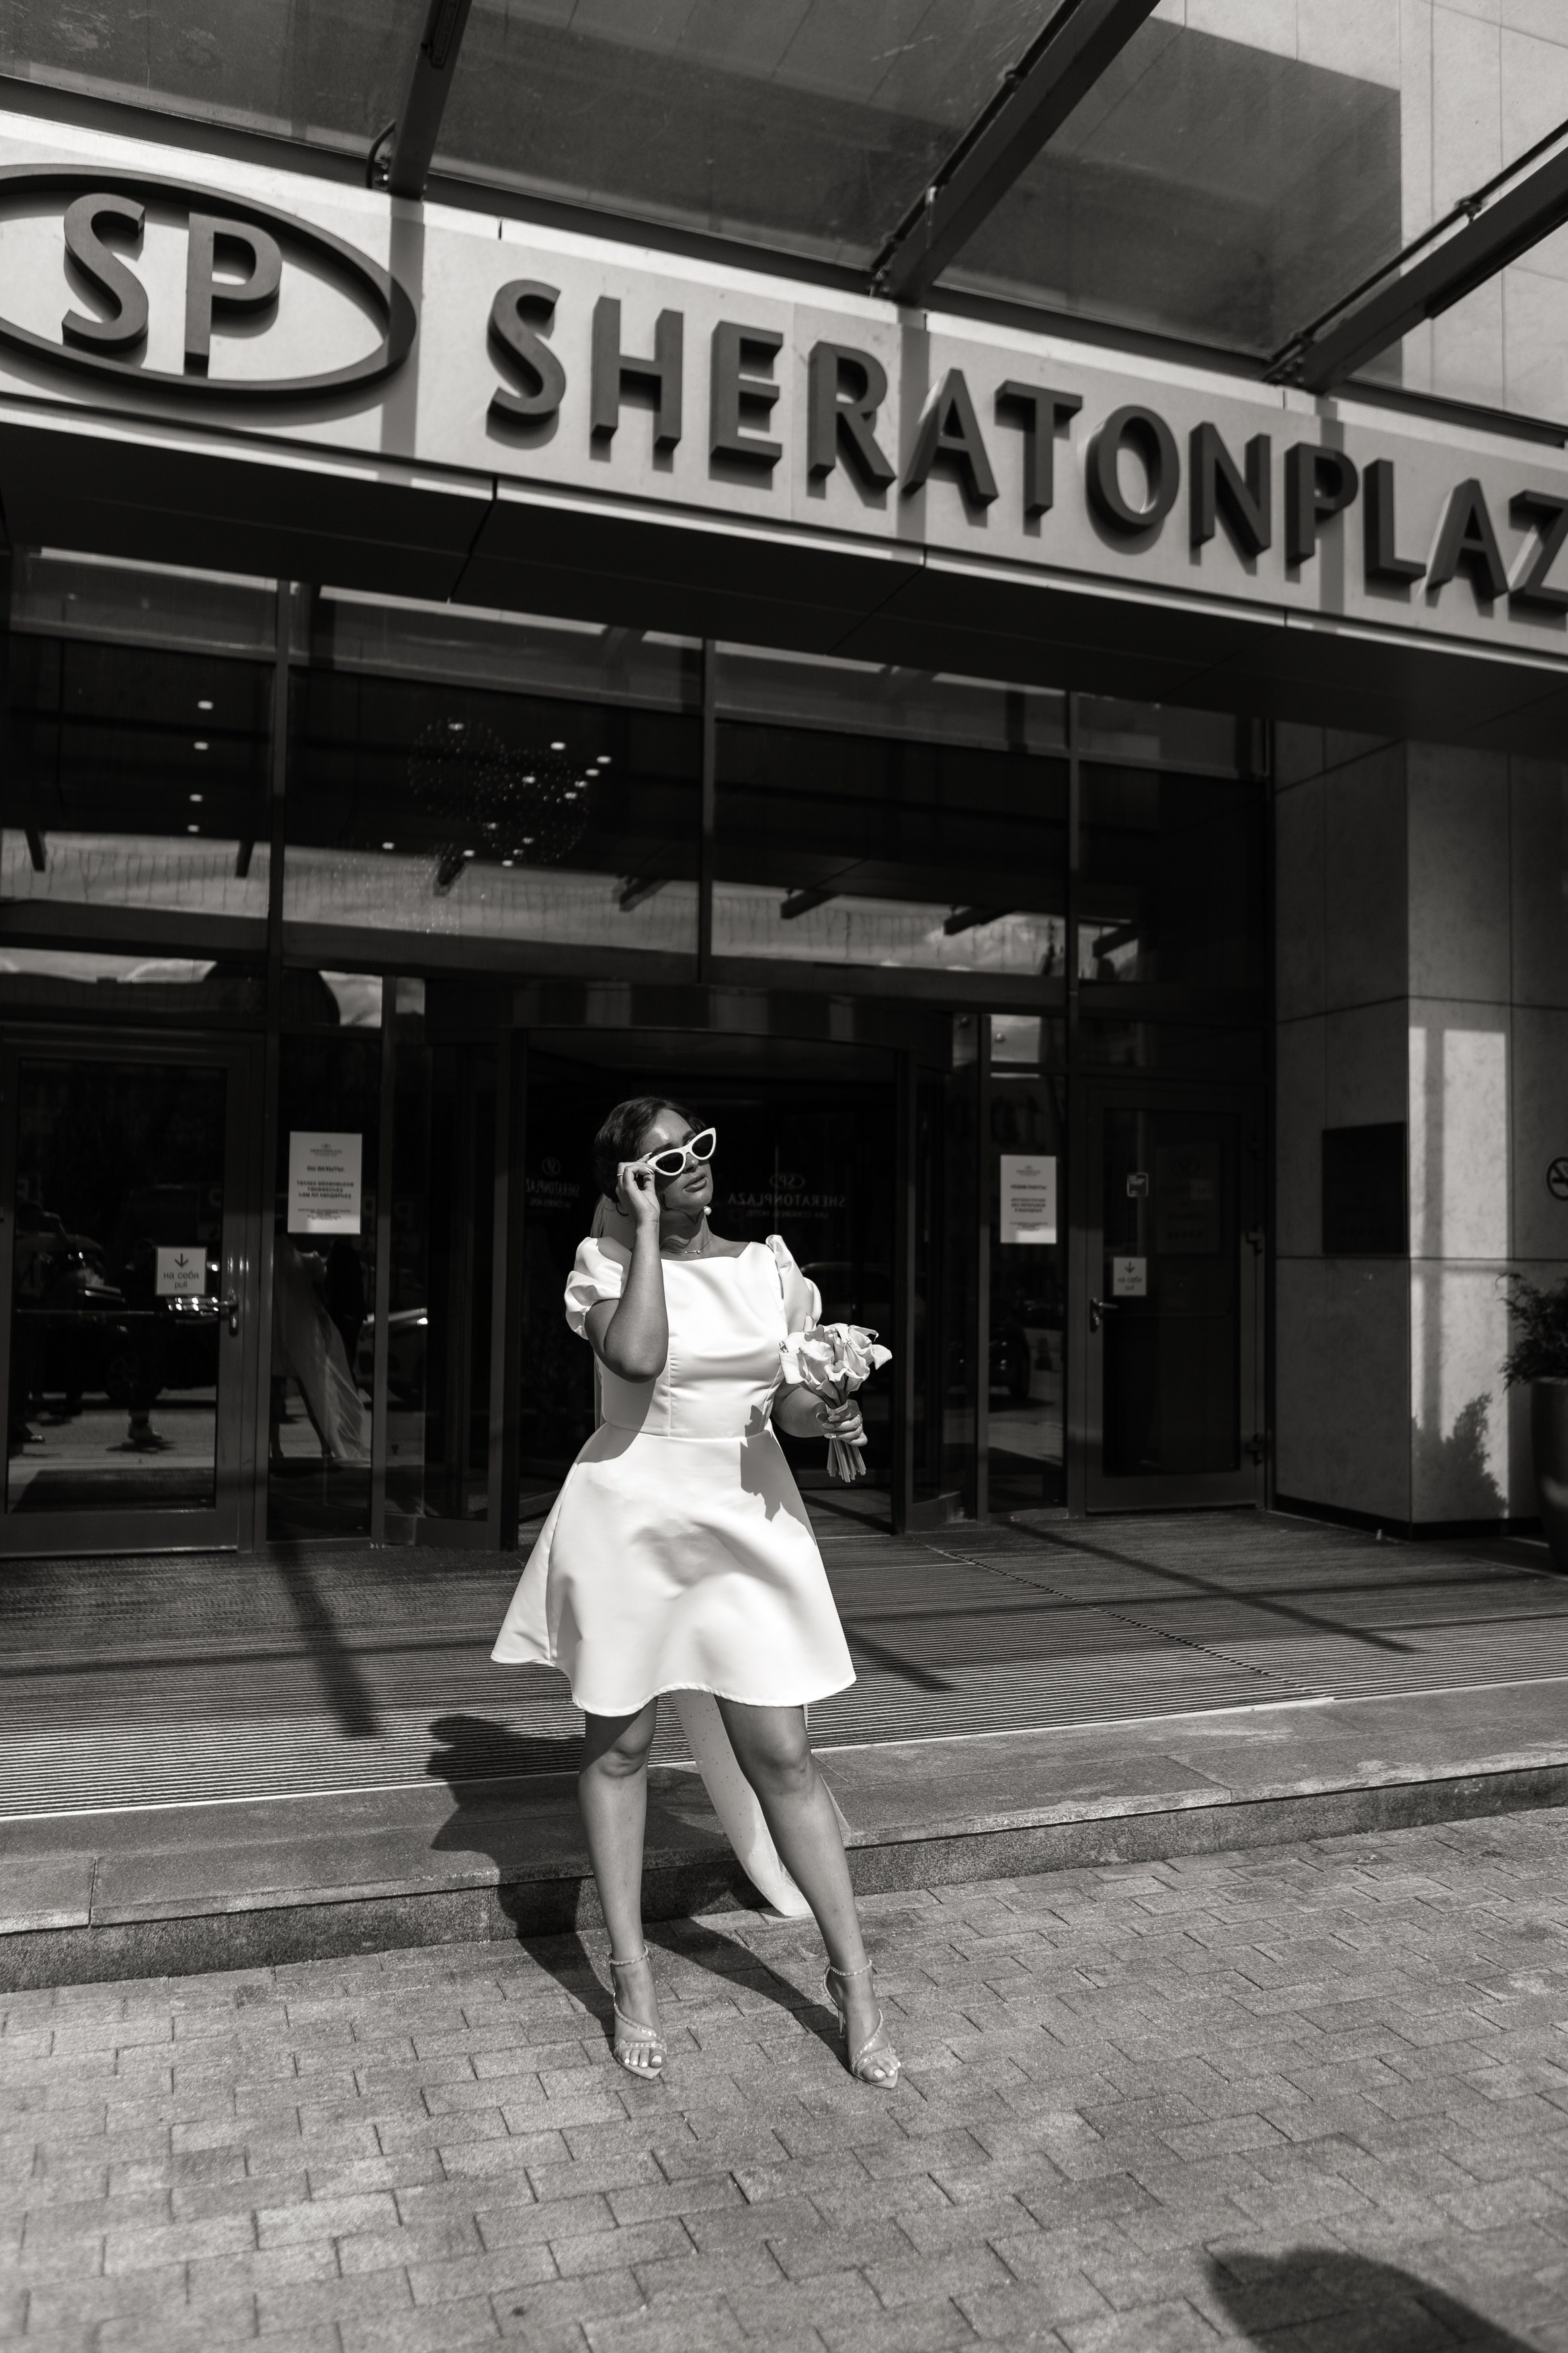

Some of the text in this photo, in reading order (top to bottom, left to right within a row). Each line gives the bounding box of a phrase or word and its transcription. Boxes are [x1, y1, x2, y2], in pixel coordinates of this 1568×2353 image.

[62, 192, 283, 376] SP
[163, 1269, 200, 1279] на себя
[174, 1281, 188, 1289] pull
